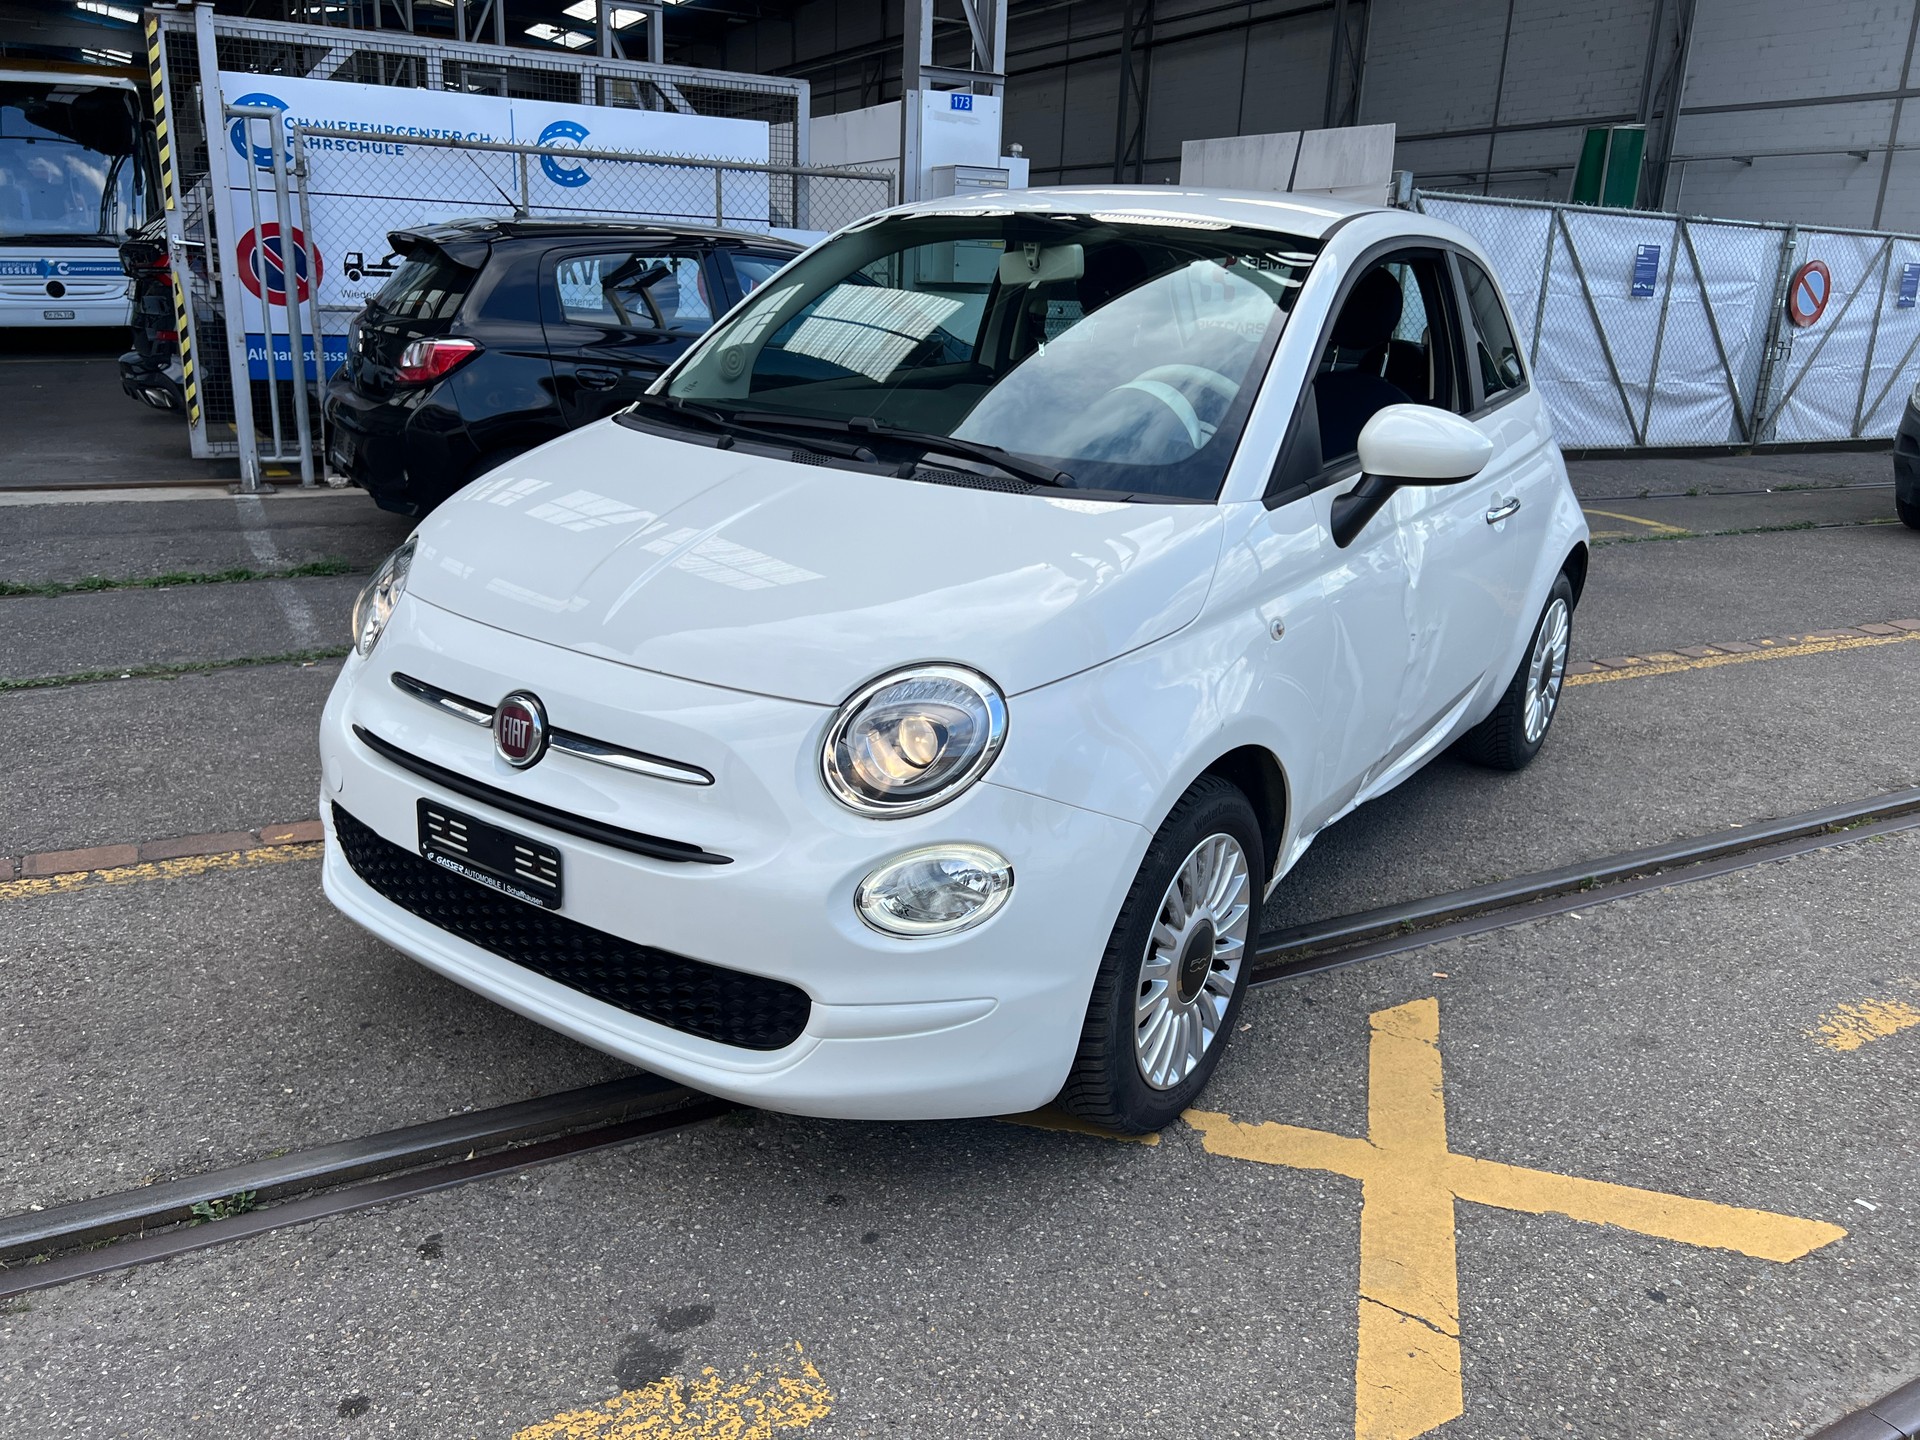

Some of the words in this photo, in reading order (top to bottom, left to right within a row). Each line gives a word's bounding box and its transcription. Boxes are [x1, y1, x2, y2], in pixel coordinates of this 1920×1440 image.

[953, 95, 970, 109] 173
[0, 266, 38, 275] ESSLER
[502, 715, 529, 749] FIAT
[436, 856, 464, 874] GASSER
[464, 868, 501, 889] AUTOMOBILE
